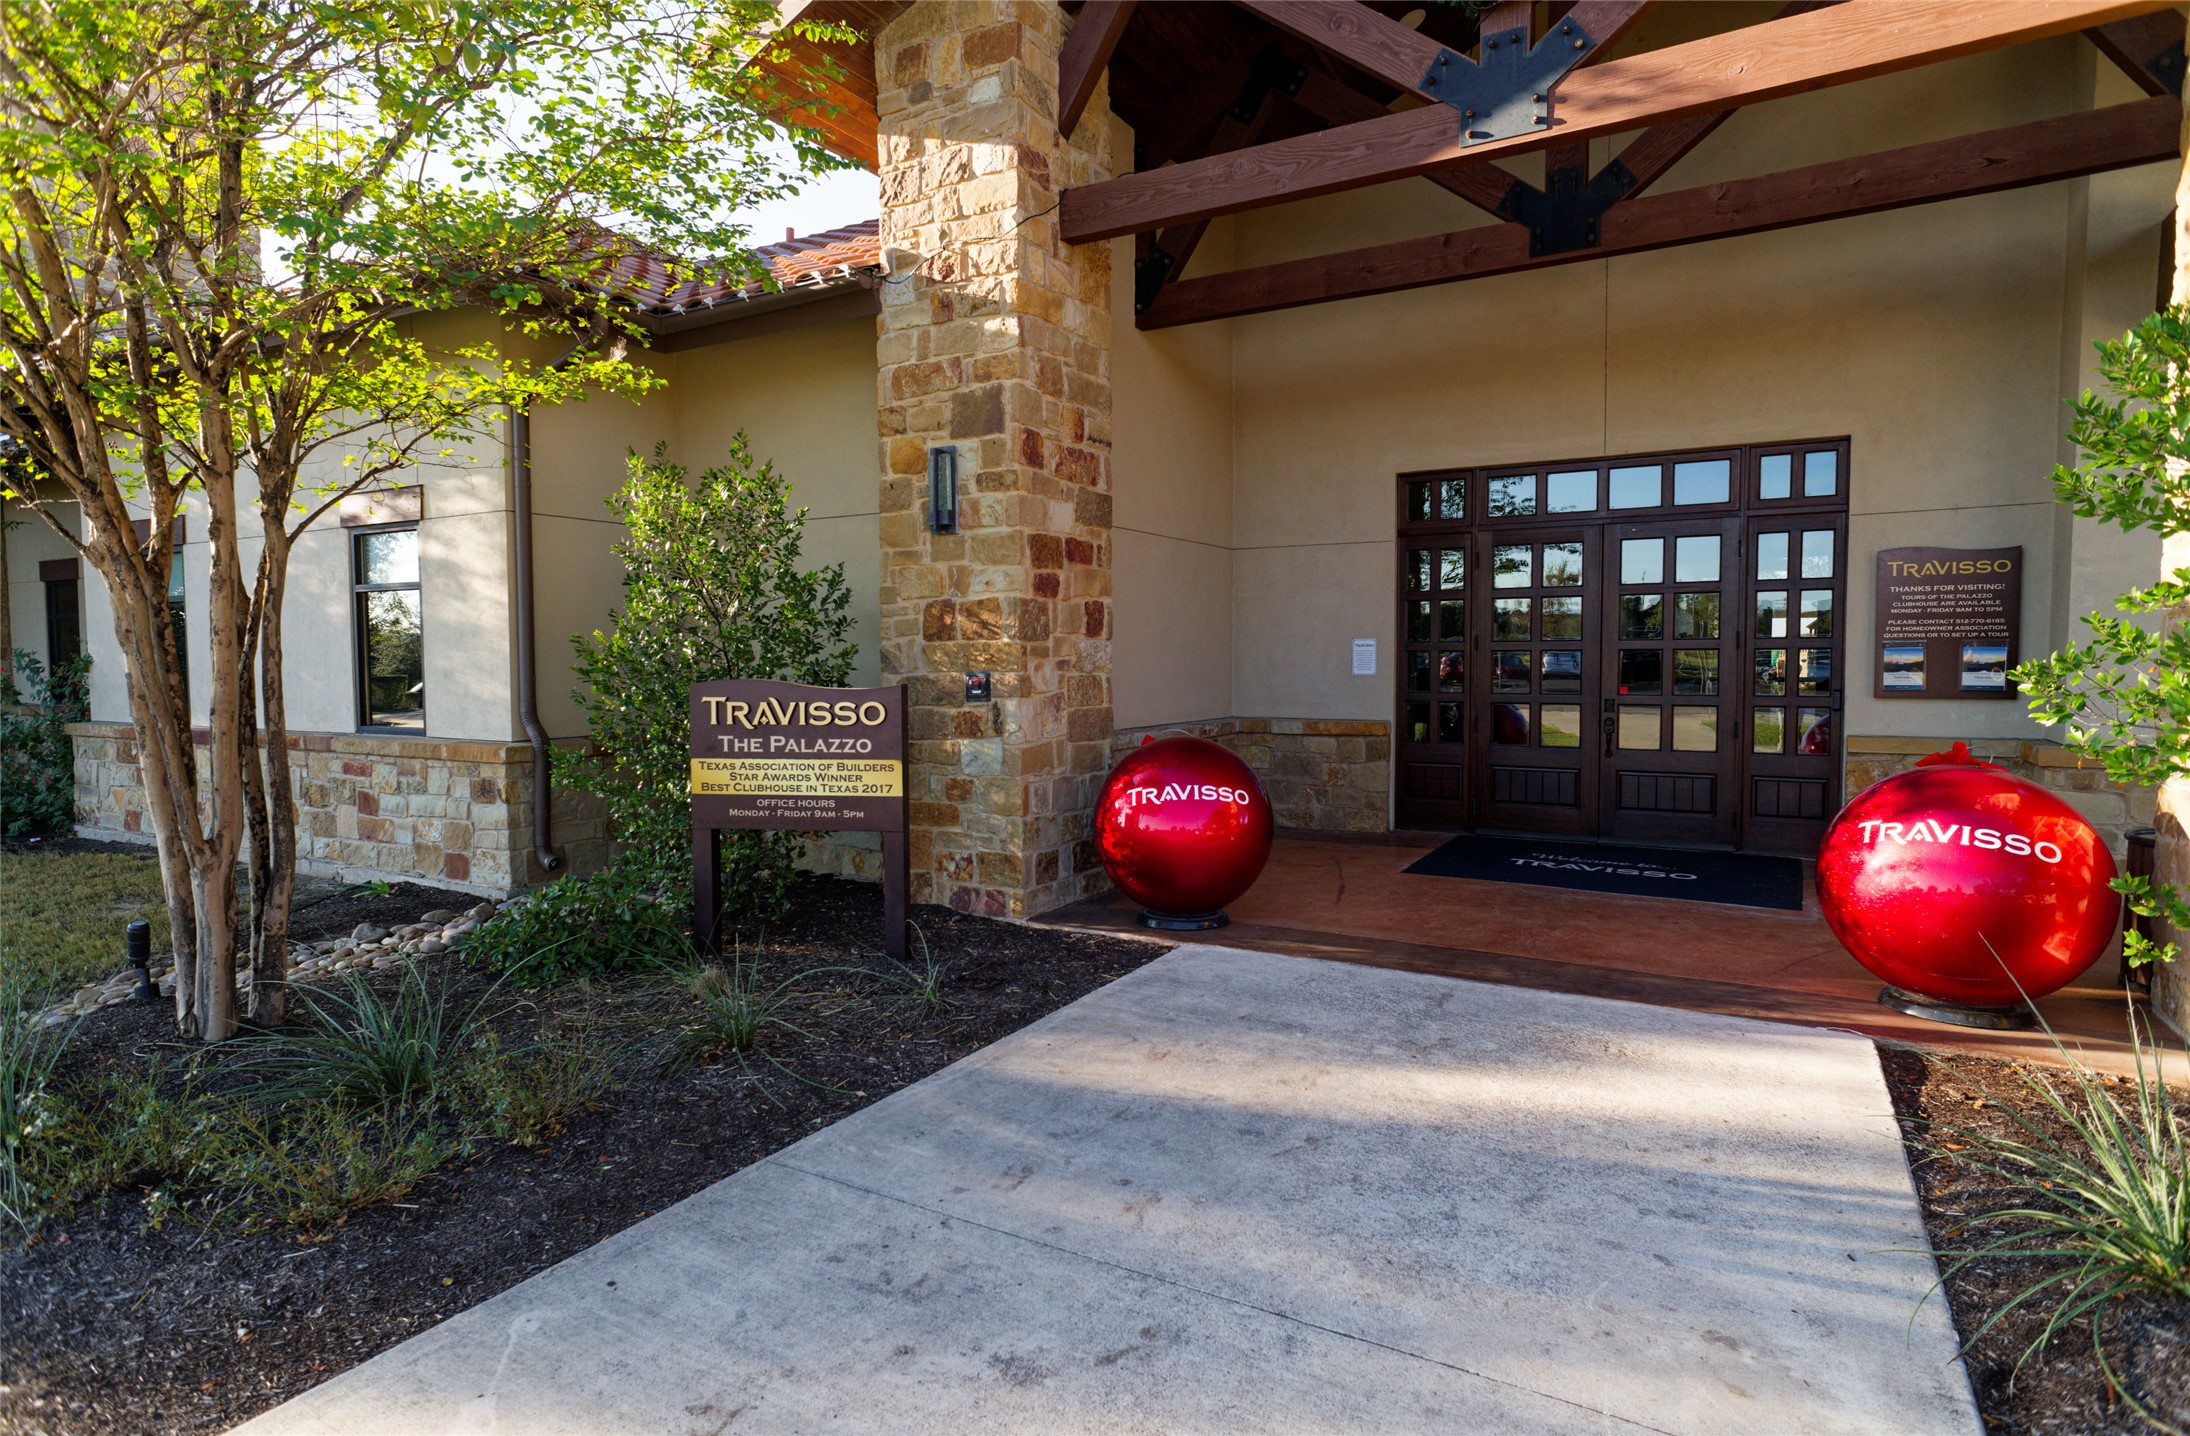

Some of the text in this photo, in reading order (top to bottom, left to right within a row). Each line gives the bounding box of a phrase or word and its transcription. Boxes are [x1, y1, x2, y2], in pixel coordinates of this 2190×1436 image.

[1887, 559, 2012, 578] TRAVISSO
[1889, 583, 2006, 593] THANKS FOR VISITING!
[701, 696, 887, 730] TRAVISSO
[718, 735, 872, 753] THE PALAZZO
[698, 761, 895, 772] TEXAS ASSOCIATION OF BUILDERS
[729, 772, 863, 783] STAR AWARDS WINNER
[701, 782, 893, 794] BEST CLUBHOUSE IN TEXAS 2017
[1127, 783, 1249, 807] TRAVISSO
[756, 798, 836, 808] OFFICE HOURS
[729, 808, 770, 817] MONDAY
[777, 809, 812, 818] FRIDAY
[814, 810, 836, 818] 9AM
[843, 810, 864, 818] 5PM
[1858, 819, 2062, 864] TRAVISSO
[1532, 853, 1634, 867] Welcome
[1510, 858, 1698, 880] TRAVISSO
